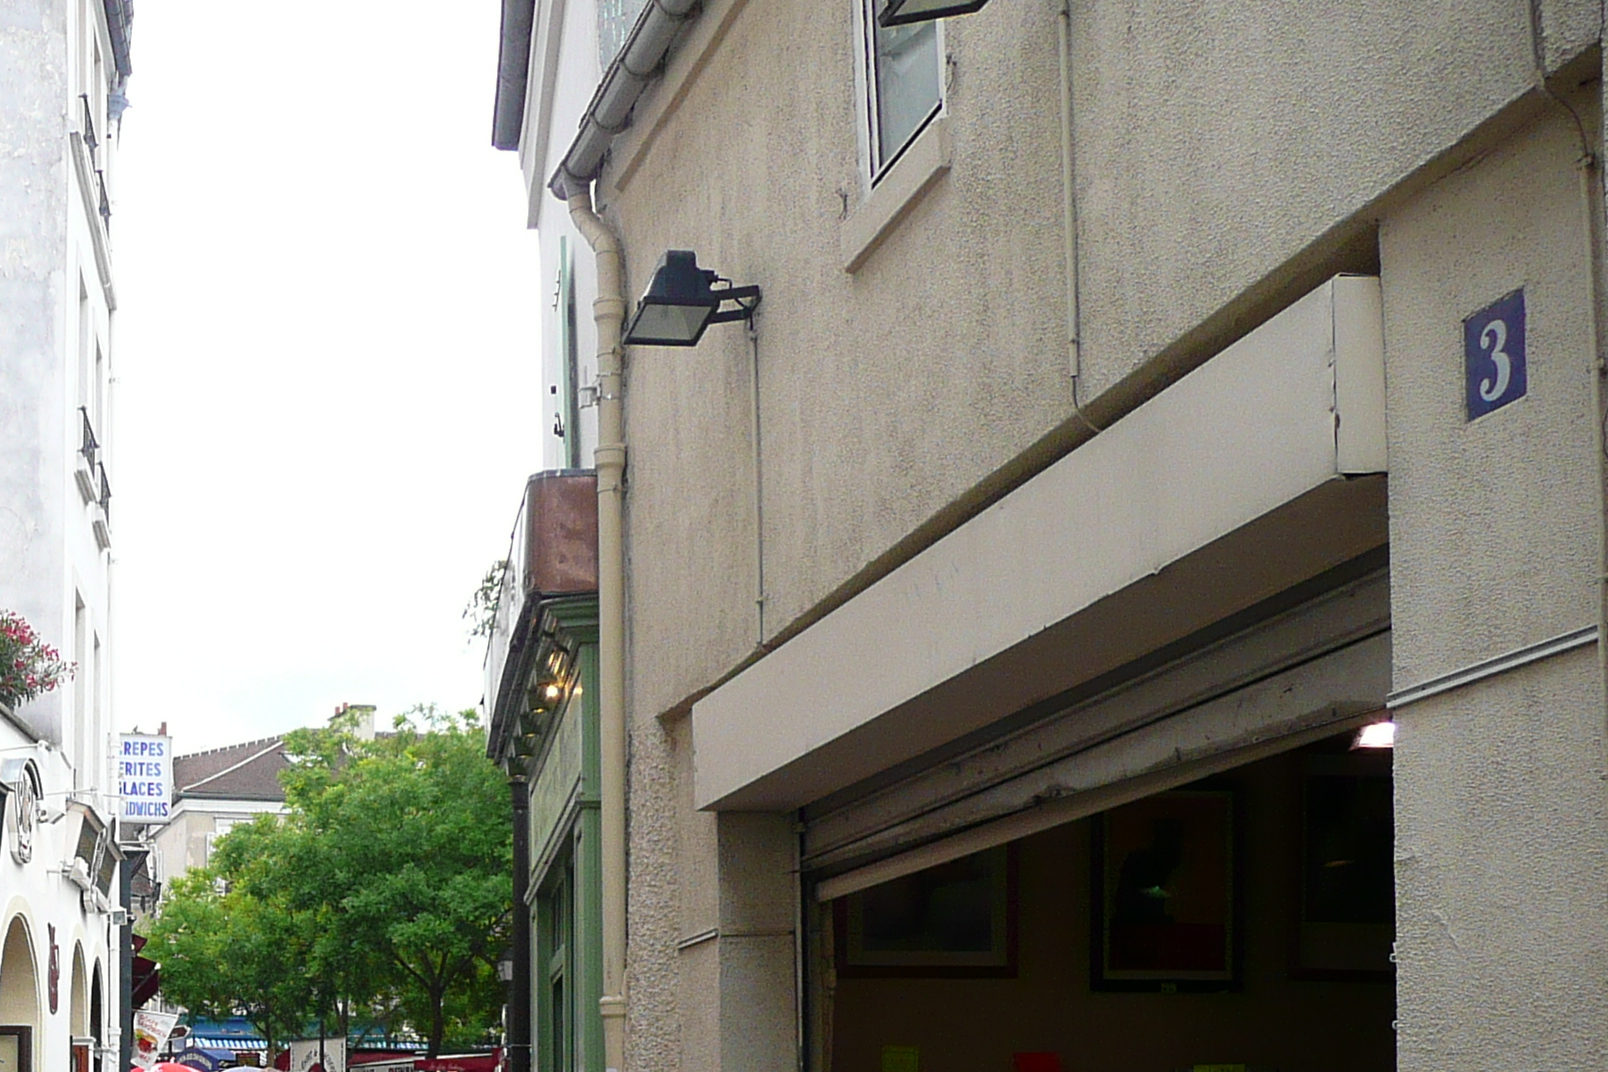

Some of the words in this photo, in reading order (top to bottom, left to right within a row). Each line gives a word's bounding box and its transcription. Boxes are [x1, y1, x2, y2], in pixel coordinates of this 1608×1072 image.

[1479, 319, 1511, 402] 3
[120, 741, 164, 756] REPES
[120, 781, 163, 797] LACES
